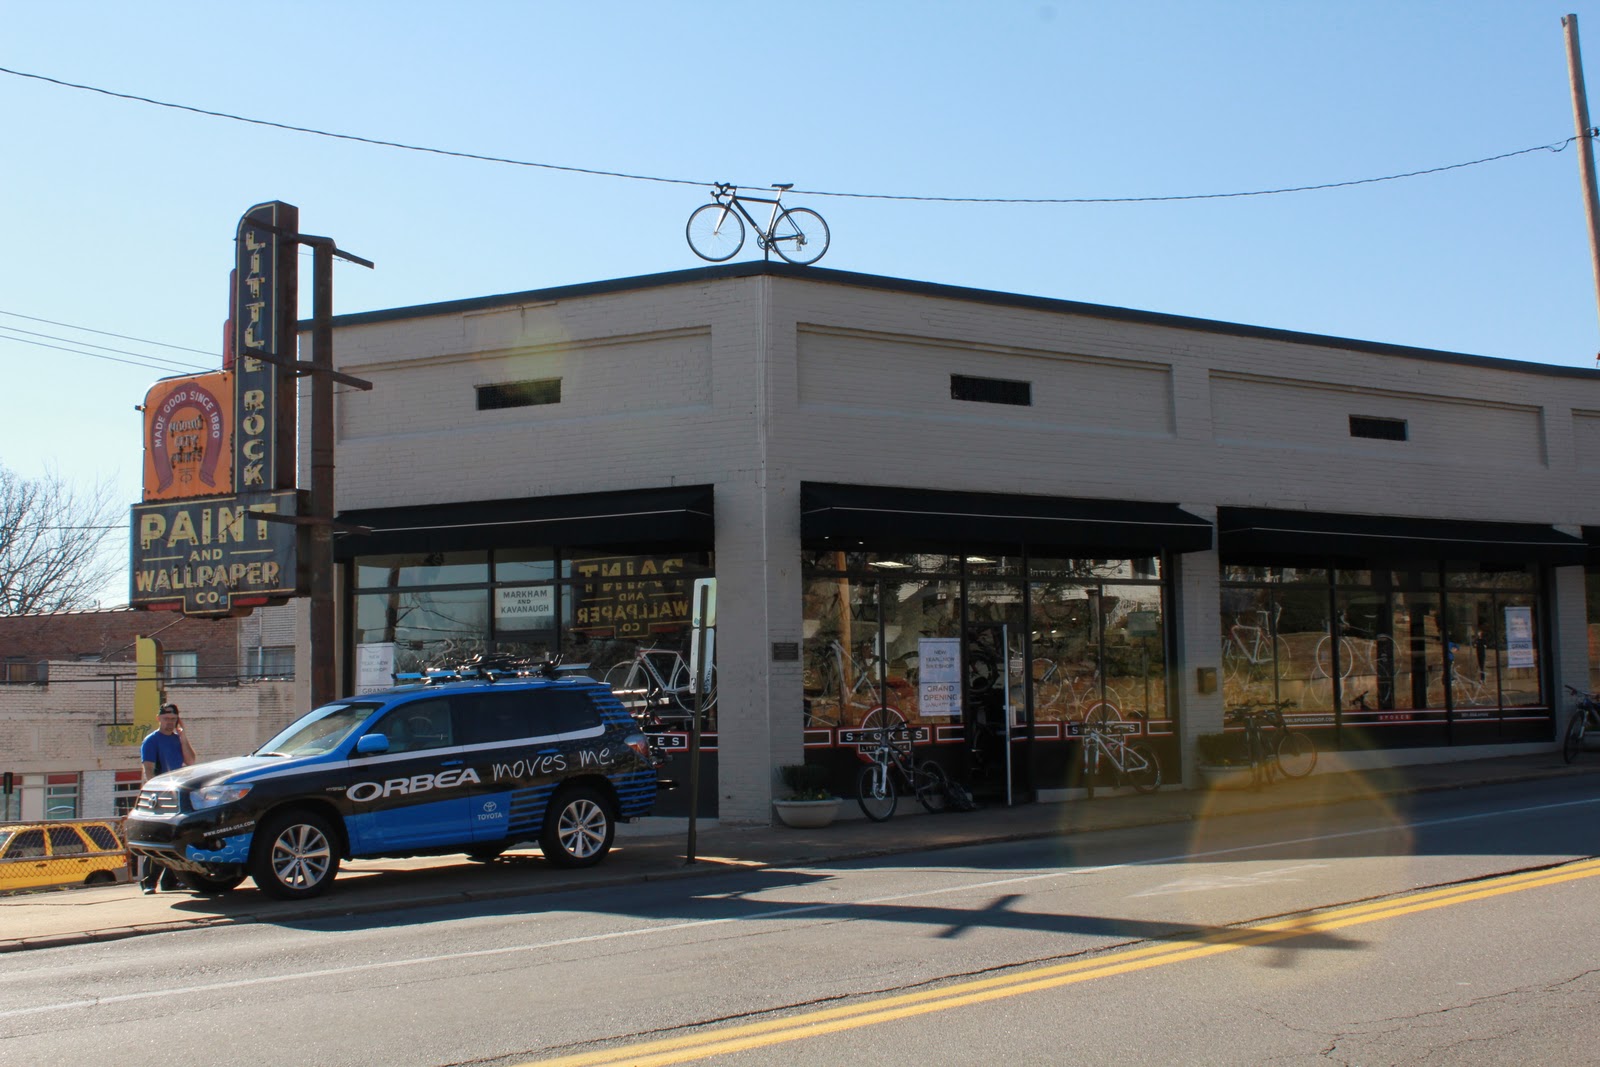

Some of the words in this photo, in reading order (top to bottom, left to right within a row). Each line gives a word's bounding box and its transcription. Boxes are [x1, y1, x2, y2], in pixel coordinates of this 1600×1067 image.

[244, 231, 266, 373] LITTLE
[154, 415, 165, 448] MADE
[163, 391, 187, 414] GOOD
[190, 390, 214, 412] SINCE
[210, 411, 220, 438] 1880
[242, 389, 265, 486] ROCK
[140, 503, 277, 550] PAINT
[189, 548, 223, 562] AND
[135, 561, 281, 593] WALLPAPER
[195, 591, 228, 605] CO
[503, 590, 548, 599] MARKHAM
[500, 604, 550, 614] KAVANAUGH
[927, 685, 955, 693] GRAND
[923, 693, 958, 701] OPENING
[345, 767, 482, 803] ORBEA
[492, 752, 567, 782] moves
[477, 812, 503, 821] TOYOTA
[203, 820, 256, 837] WWW.ORBEA-USA.COM
